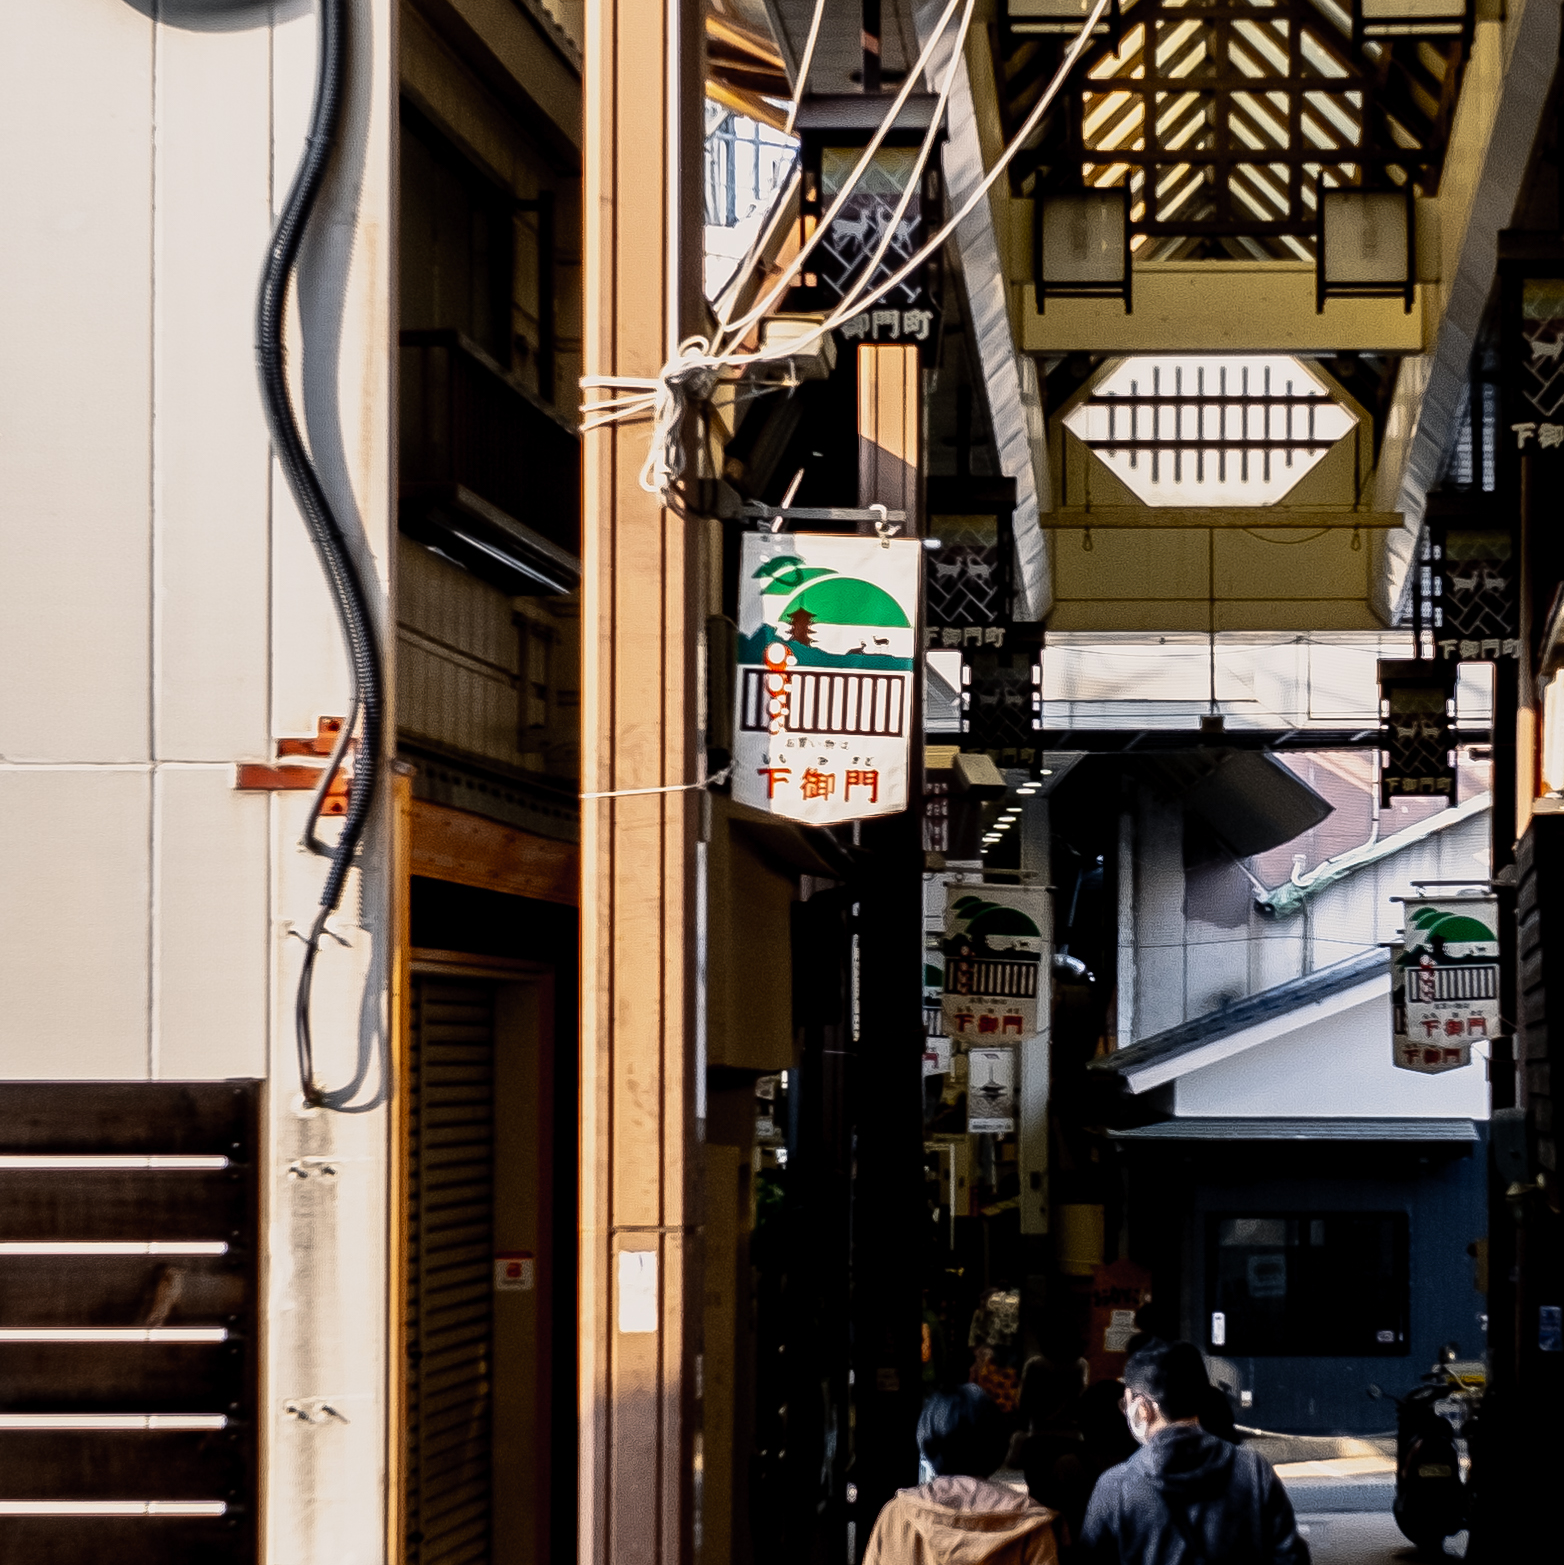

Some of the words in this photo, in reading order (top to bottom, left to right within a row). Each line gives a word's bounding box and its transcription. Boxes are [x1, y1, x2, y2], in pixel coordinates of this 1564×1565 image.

[756, 767, 879, 804] 下御門
[956, 1014, 1023, 1035] 下御門
[1421, 1018, 1488, 1037] 下御門
